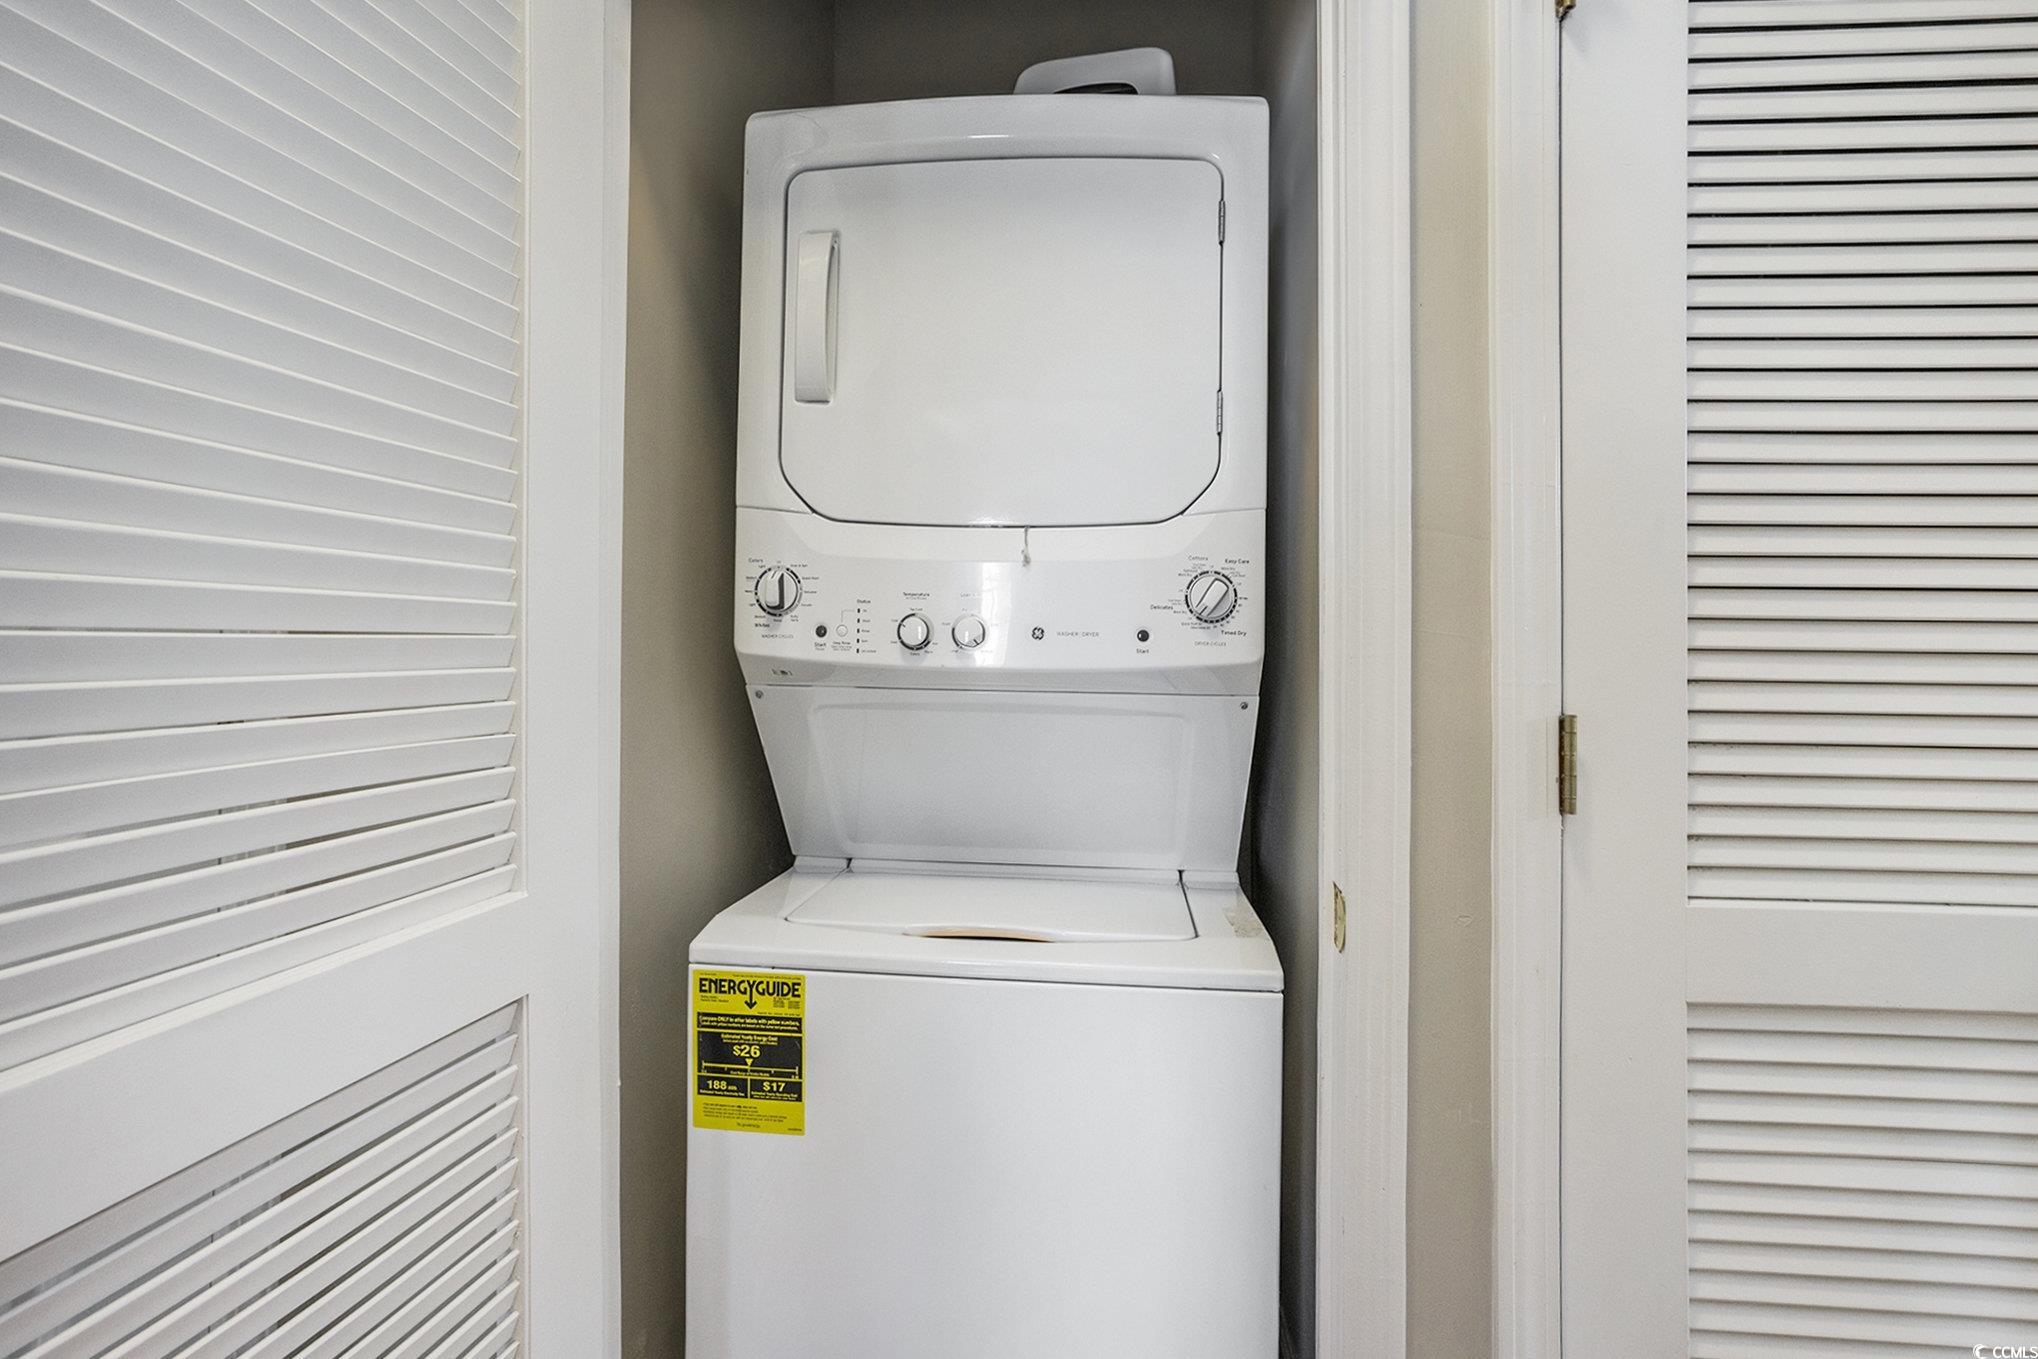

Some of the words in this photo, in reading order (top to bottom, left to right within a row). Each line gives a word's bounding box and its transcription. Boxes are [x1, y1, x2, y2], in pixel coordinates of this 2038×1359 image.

[699, 977, 801, 1000] ENERGYGUIDE
[733, 1044, 761, 1058] $26
[707, 1080, 728, 1090] 188
[763, 1081, 786, 1092] $17
